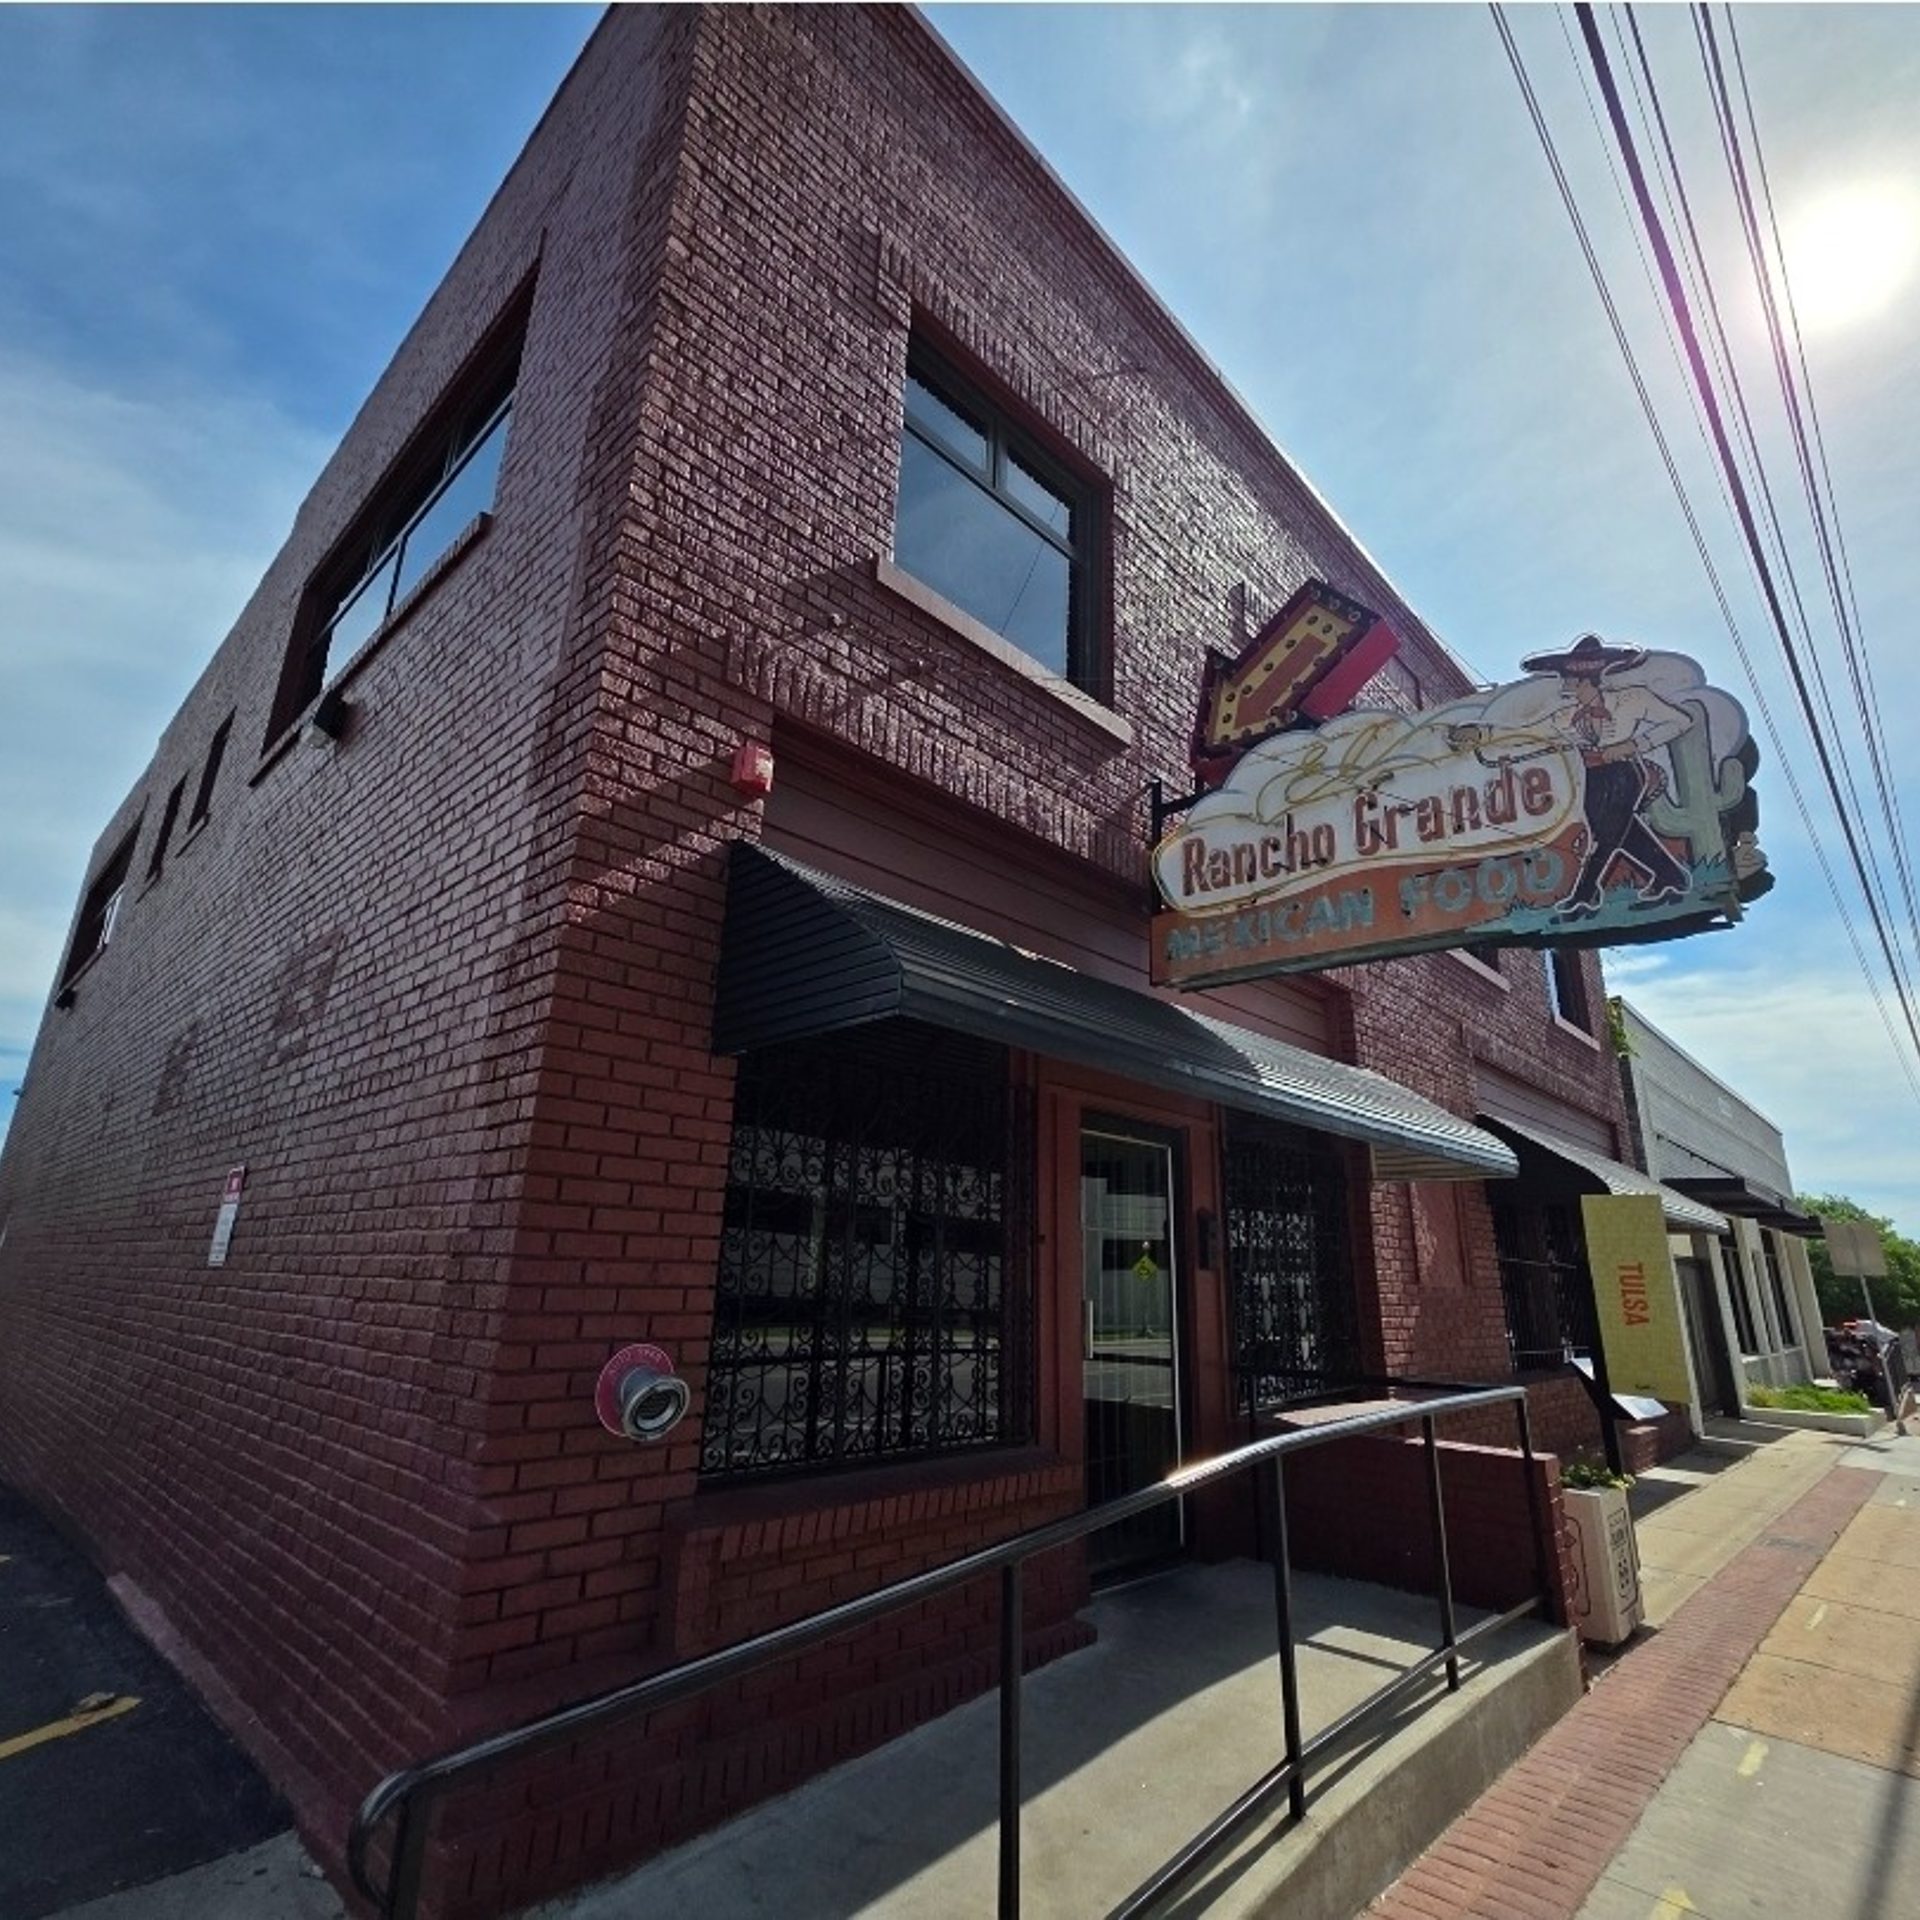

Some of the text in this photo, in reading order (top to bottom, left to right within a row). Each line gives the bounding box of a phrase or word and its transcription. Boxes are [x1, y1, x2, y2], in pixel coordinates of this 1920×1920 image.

[1181, 755, 1555, 897] Rancho Grande
[1167, 848, 1564, 960] MEXICAN FOOD
[1617, 1262, 1650, 1327] TULSA
